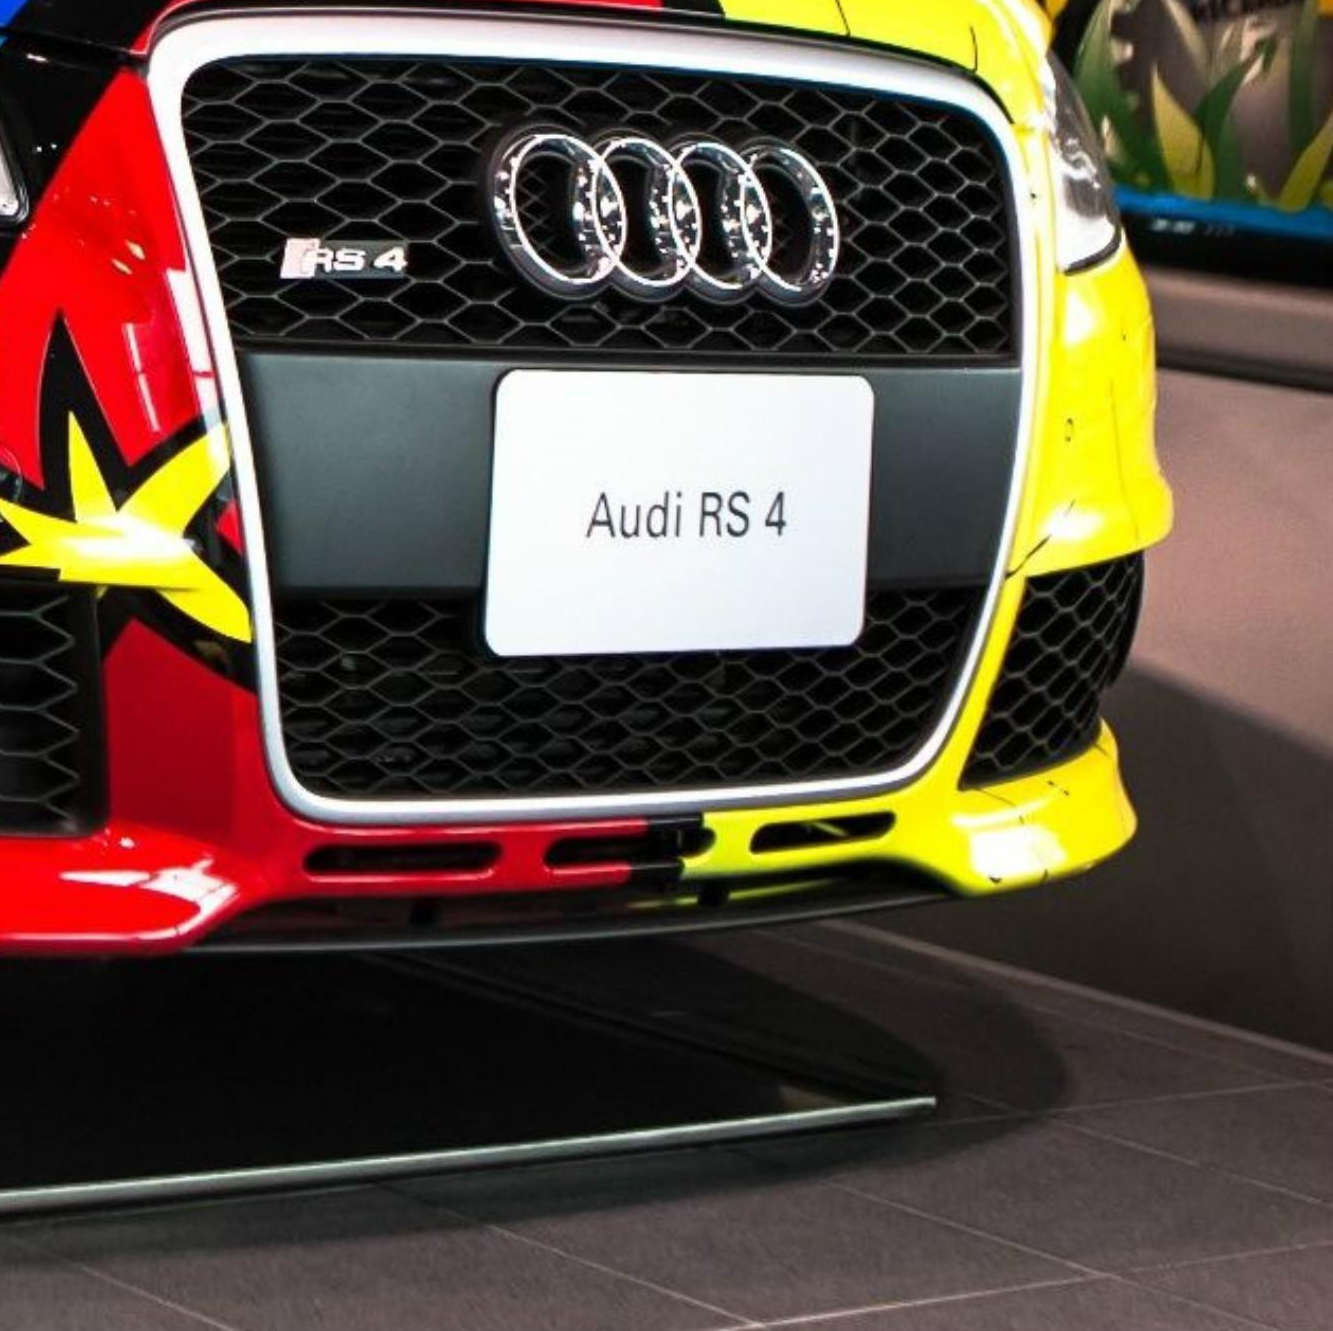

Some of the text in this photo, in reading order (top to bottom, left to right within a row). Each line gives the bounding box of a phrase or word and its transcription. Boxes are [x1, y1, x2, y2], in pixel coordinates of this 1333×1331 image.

[295, 245, 408, 273] RS 4
[586, 490, 787, 538] Audi RS 4
